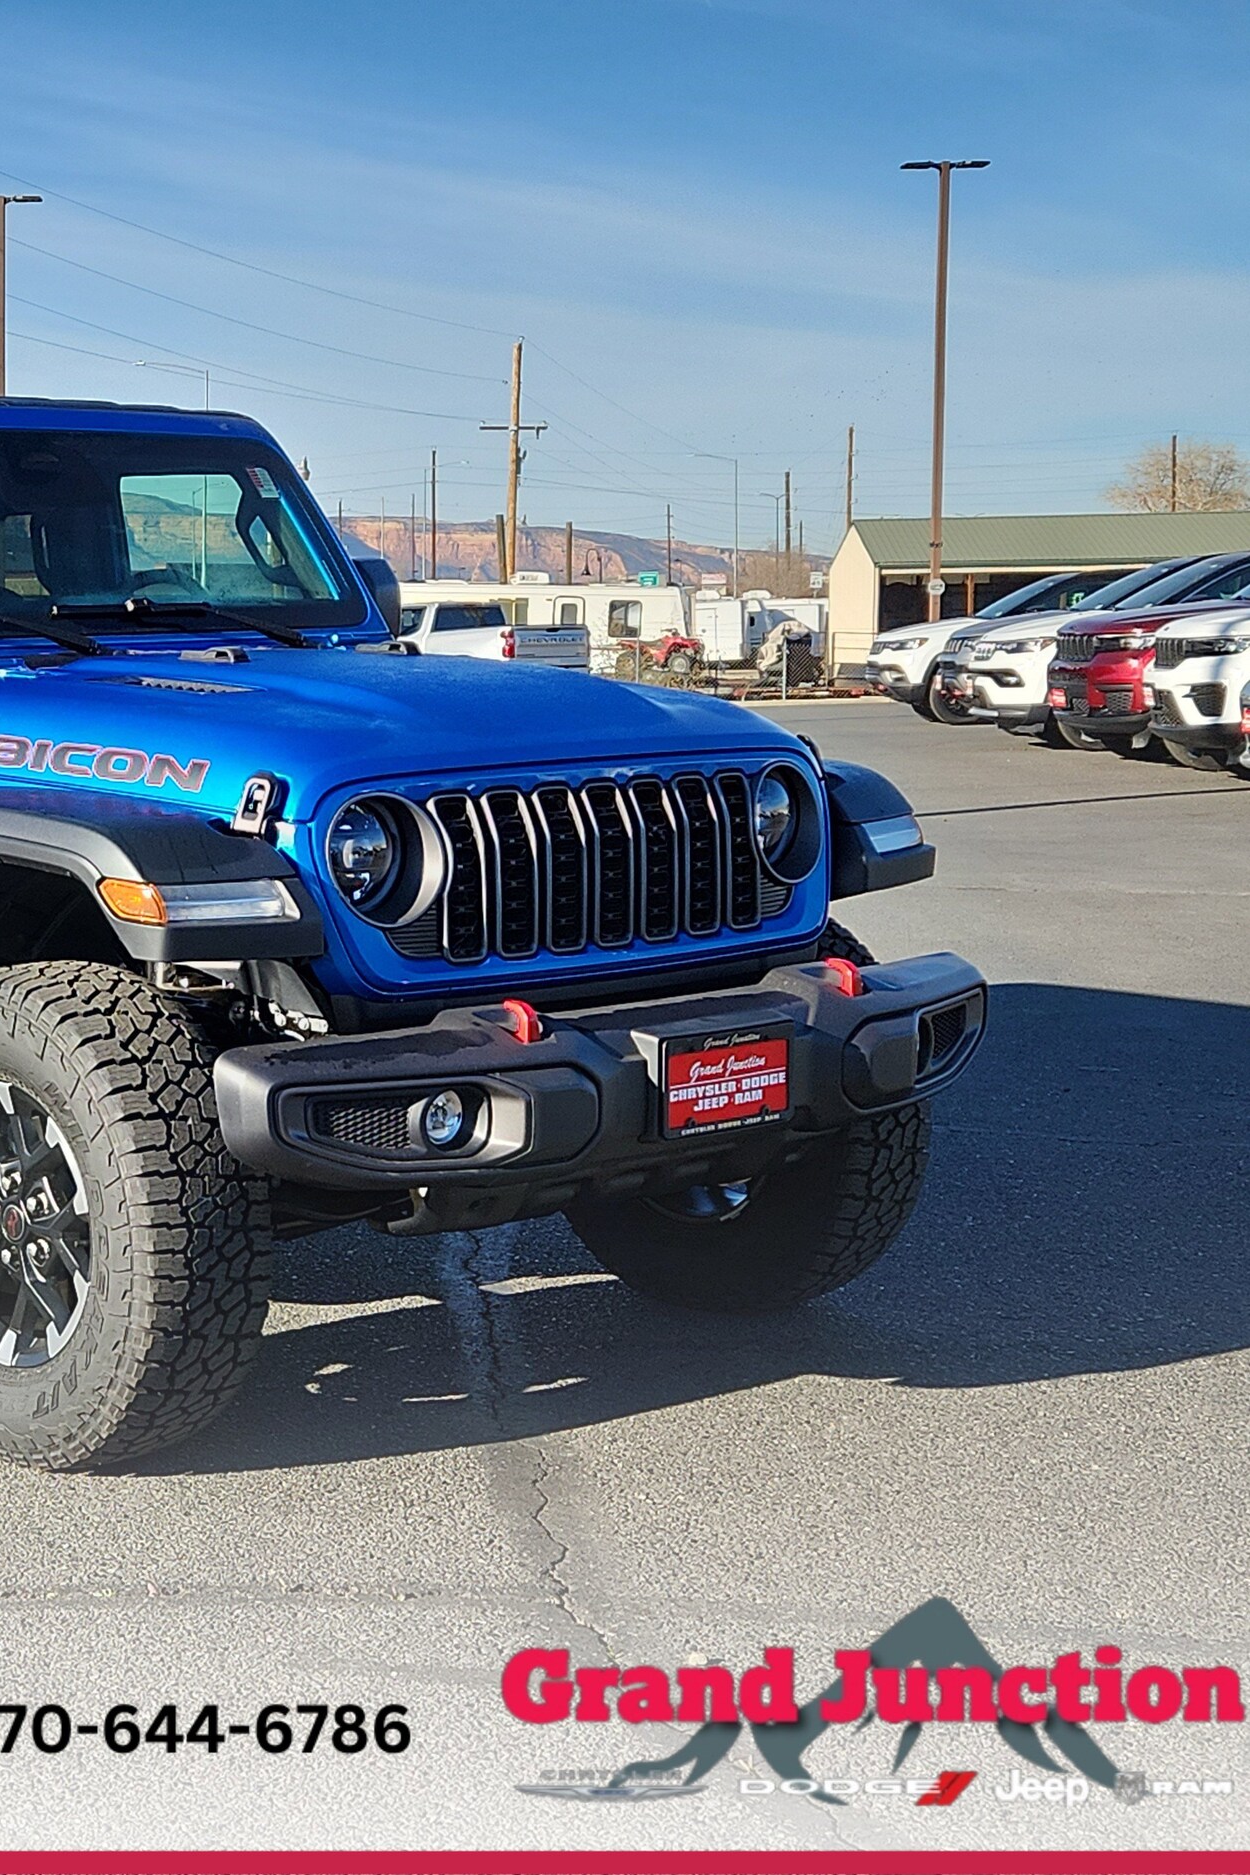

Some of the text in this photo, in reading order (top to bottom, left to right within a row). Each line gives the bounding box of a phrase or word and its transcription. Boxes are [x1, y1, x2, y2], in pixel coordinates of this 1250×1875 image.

[690, 1055, 766, 1084] Grand Junction
[669, 1072, 787, 1102] CHRYSLER DODGE
[693, 1089, 763, 1112] JEEP RAM
